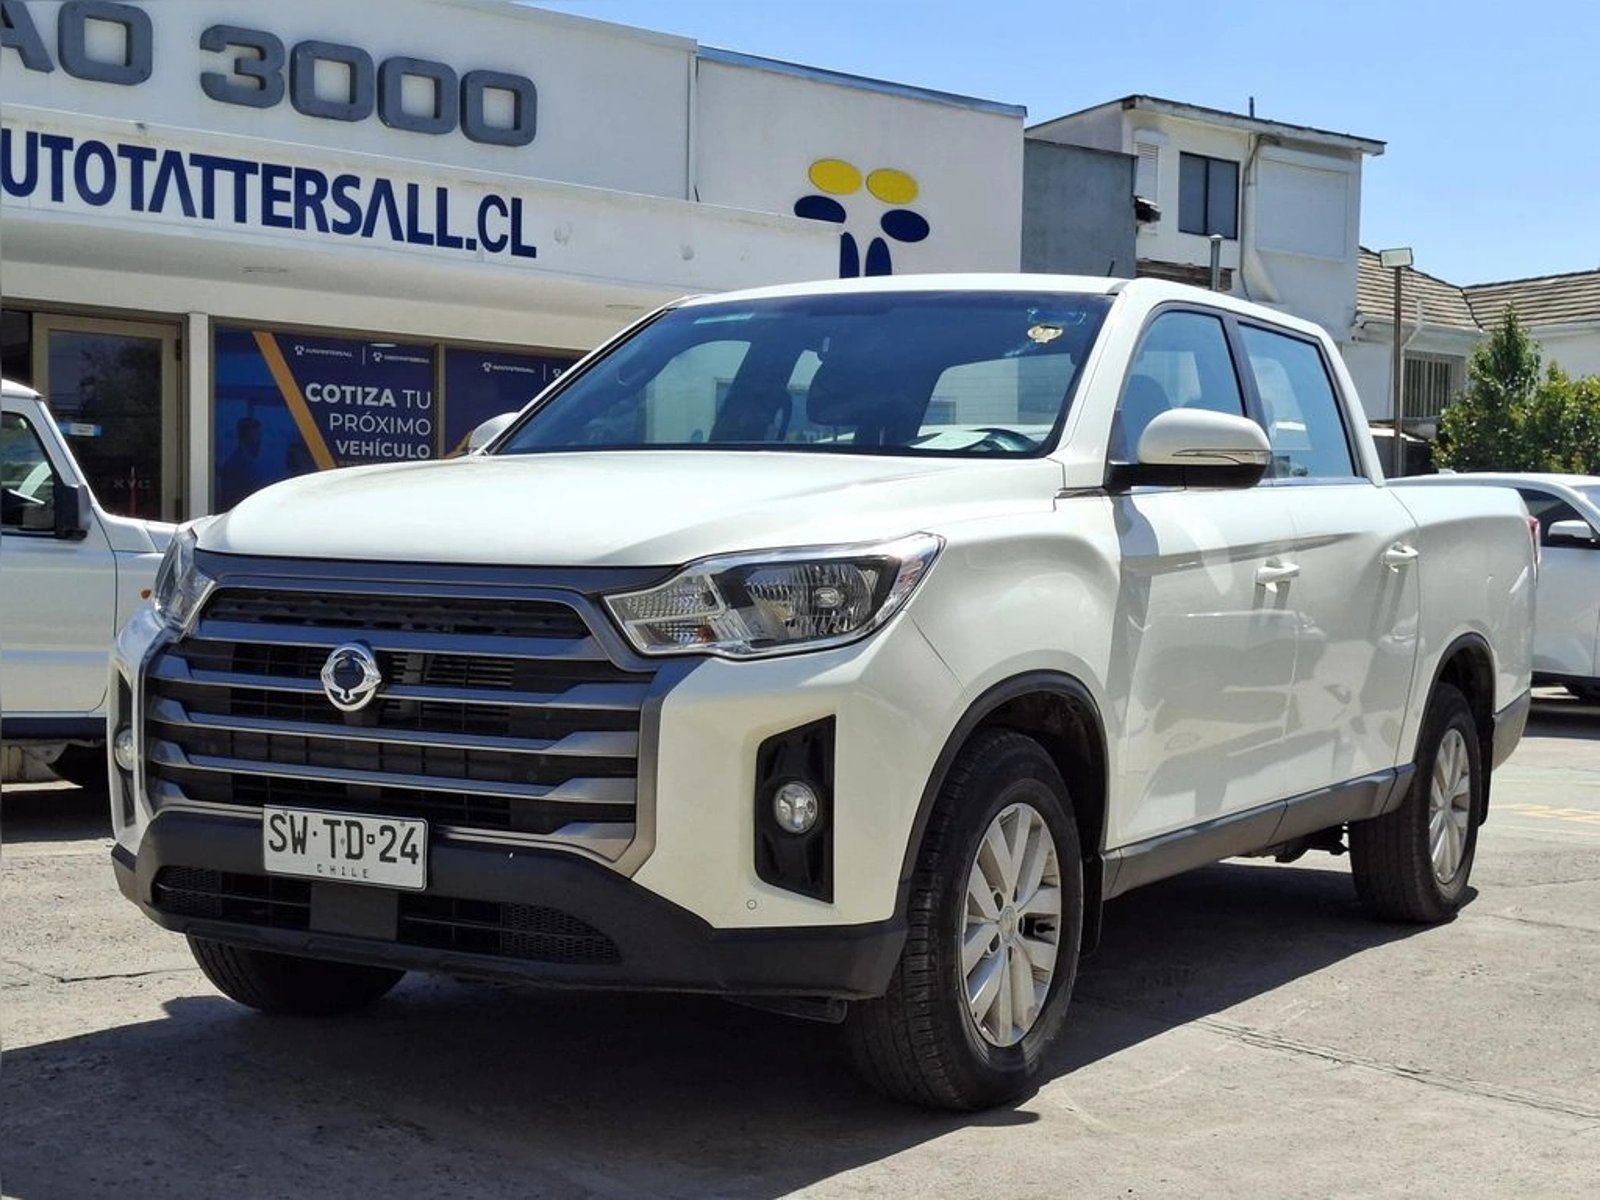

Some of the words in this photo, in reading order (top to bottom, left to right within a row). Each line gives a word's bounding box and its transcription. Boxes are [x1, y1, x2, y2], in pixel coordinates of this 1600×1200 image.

[200, 24, 538, 147] 3000
[305, 382, 397, 408] COTIZA
[402, 389, 431, 409] TU
[329, 411, 432, 436] PRÓXIMO
[336, 438, 431, 459] VEHÍCULO
[316, 863, 370, 879] CHILE
